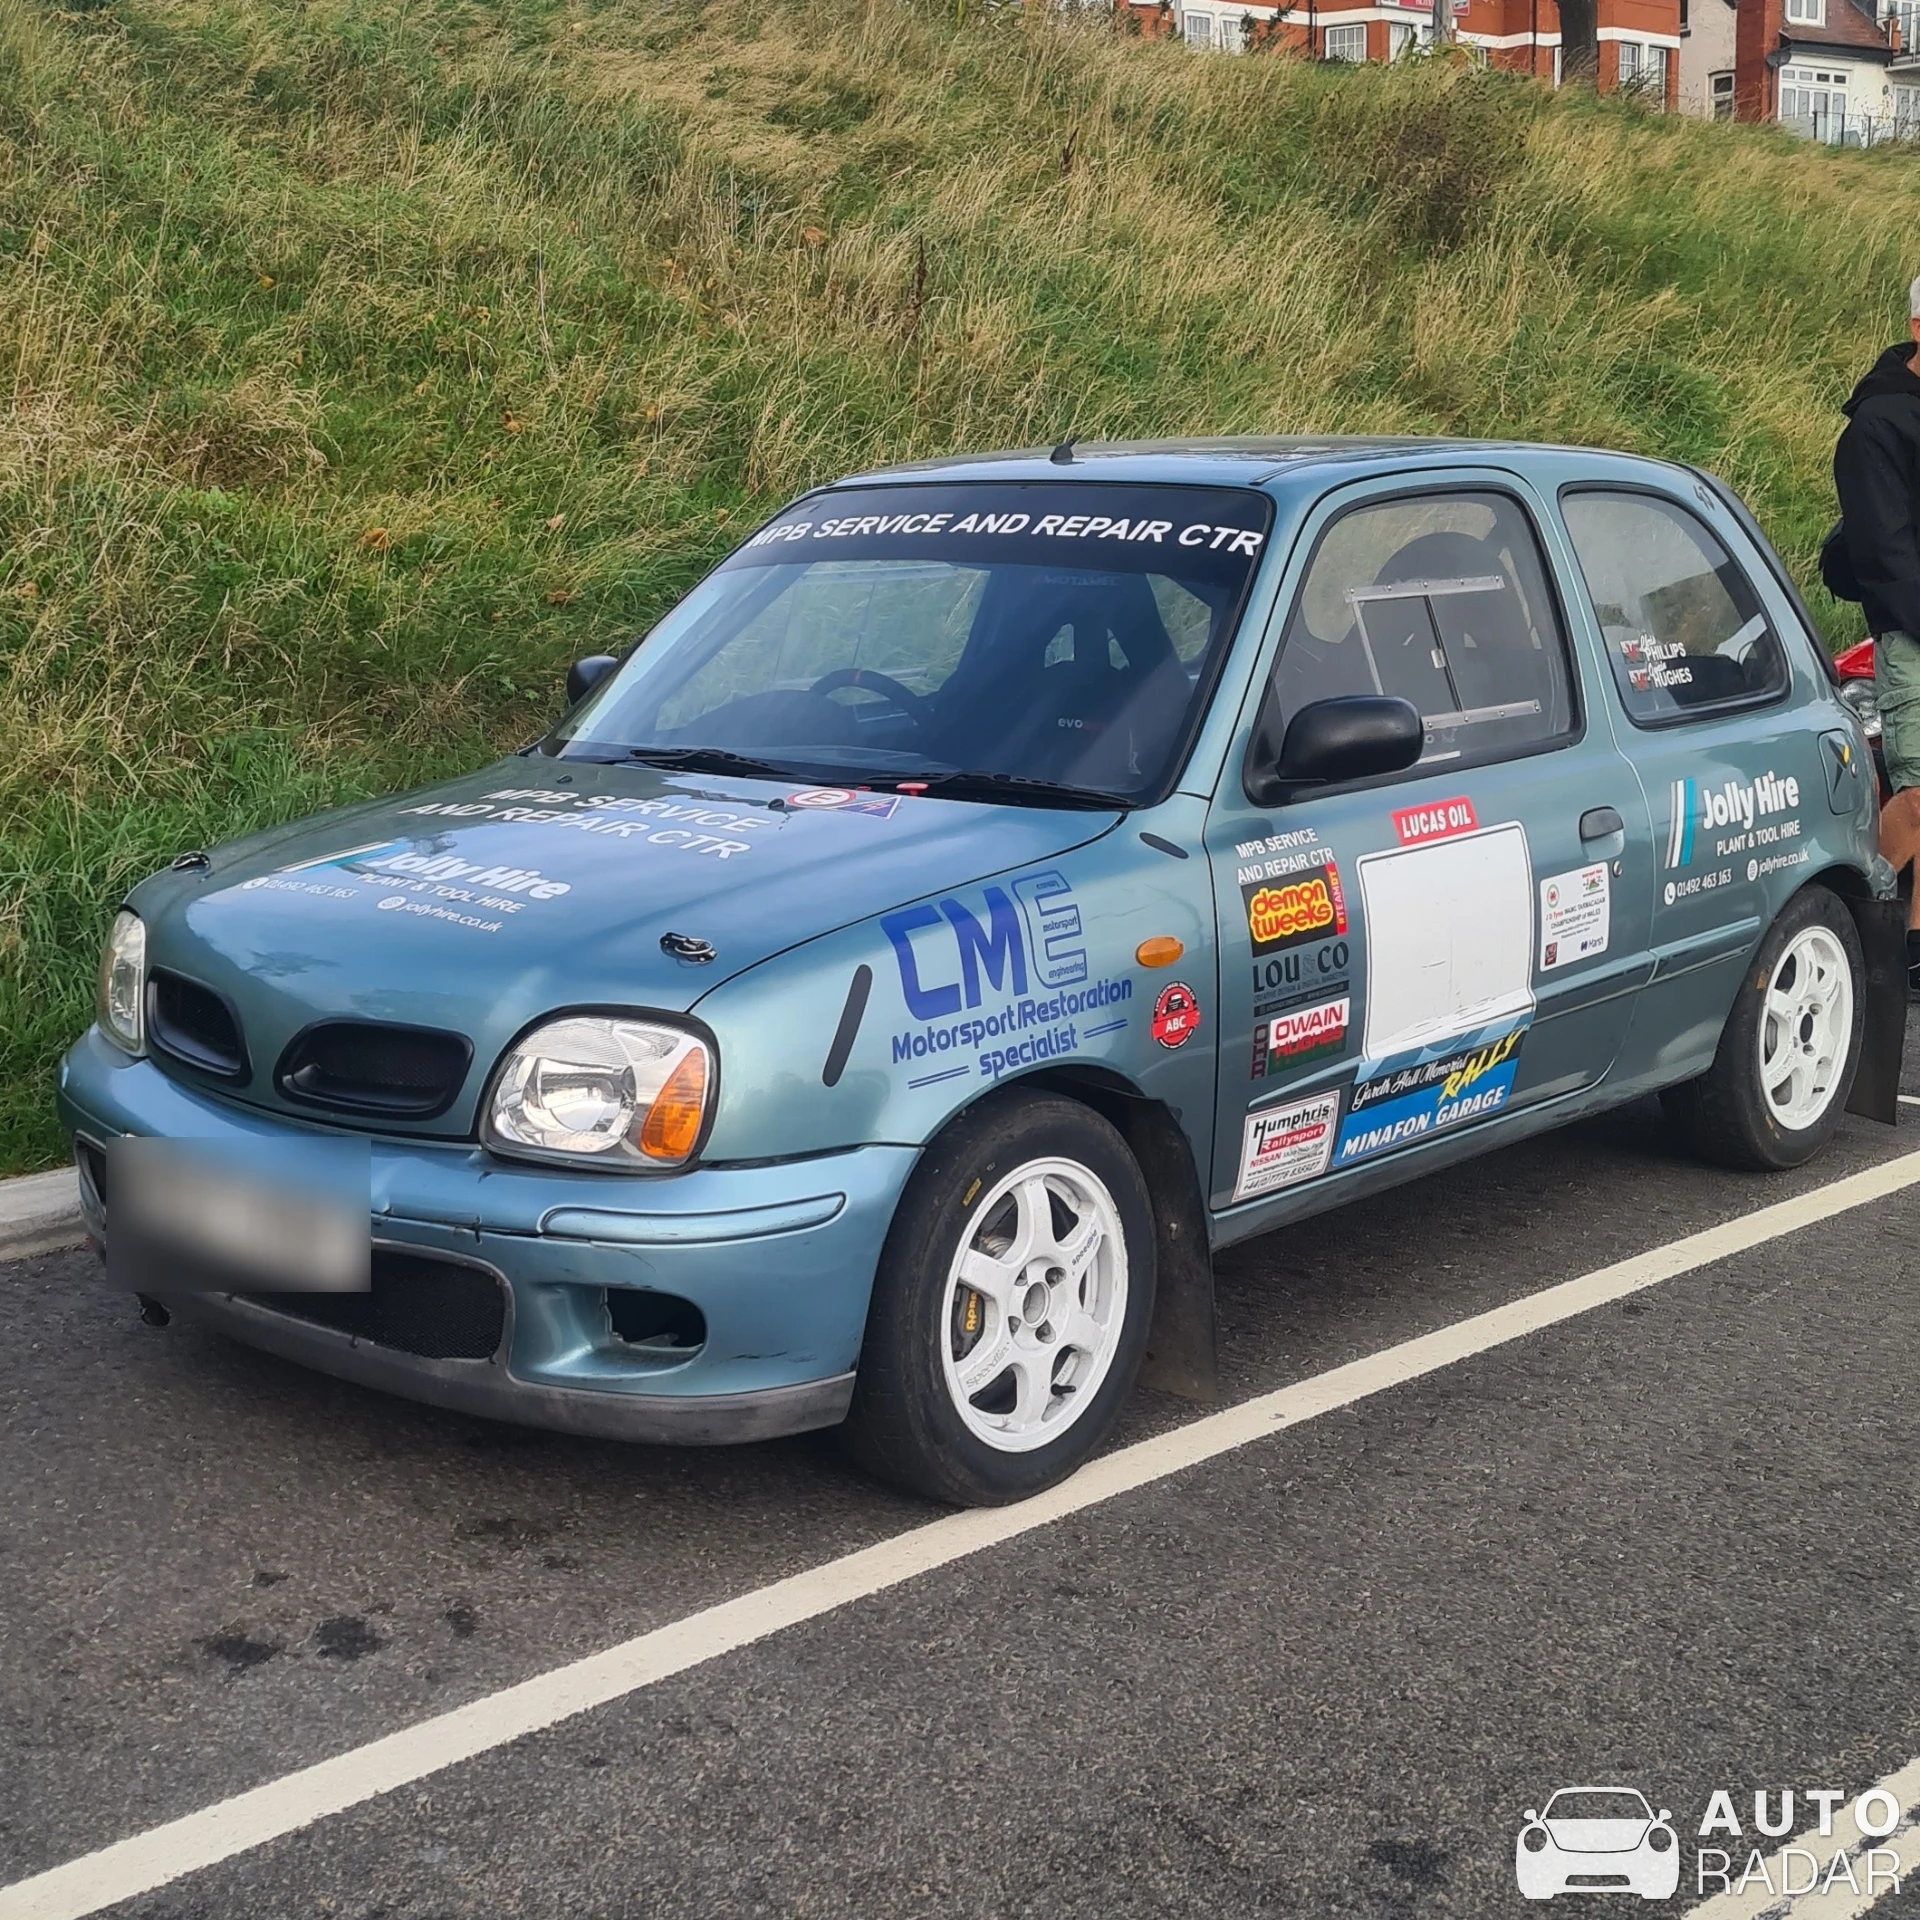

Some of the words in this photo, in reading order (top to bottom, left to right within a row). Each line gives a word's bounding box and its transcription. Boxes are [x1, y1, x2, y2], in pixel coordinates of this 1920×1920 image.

[748, 521, 811, 548] MPB
[813, 513, 954, 538] SERVICE
[949, 513, 1030, 535] AND
[1032, 515, 1173, 543] REPAIR
[1178, 524, 1263, 555] CTR
[1645, 642, 1686, 661] PHILLIPS
[1654, 667, 1692, 688] HUGHES
[479, 789, 579, 804] MPB
[574, 795, 772, 832] SERVICE
[1703, 781, 1754, 830] Jolly
[1754, 770, 1799, 815] Hire
[397, 803, 496, 816] AND
[486, 806, 650, 838] REPAIR
[647, 829, 751, 859] CTR
[1401, 808, 1447, 838] LUCAS
[1448, 803, 1472, 828] OIL
[1716, 833, 1747, 857] PLANT
[1747, 832, 1755, 848] &
[1756, 826, 1780, 846] TOOL
[1780, 819, 1801, 840] HIRE
[1235, 840, 1266, 859] MPB
[1265, 828, 1319, 852] SERVICE
[366, 852, 486, 882] Jolly
[465, 865, 571, 900] Hire
[1237, 864, 1263, 884] AND
[1264, 853, 1309, 878] REPAIR
[1310, 847, 1335, 869] CTR
[1758, 847, 1809, 878] jollyhire.co.uk
[355, 872, 417, 889] PLANT
[410, 882, 429, 892] &
[427, 885, 473, 903] TOOL
[475, 895, 526, 914] HIRE
[1252, 880, 1327, 916] demon
[1677, 877, 1701, 897] 01492
[1701, 872, 1716, 888] 463
[1718, 868, 1732, 885] 163
[397, 900, 503, 933] jollyhire.co.uk
[1251, 903, 1332, 941] tweeks
[1165, 1015, 1186, 1034] ABC
[1275, 1004, 1343, 1041] OWAIN
[979, 1024, 1078, 1080] specialist
[1437, 1024, 1529, 1106] RALLY
[1352, 1076, 1391, 1111] Gareth
[1391, 1069, 1420, 1094] Hall
[1419, 1052, 1470, 1084] Memorial
[1253, 1104, 1330, 1156] Humphris
[1261, 1125, 1324, 1151] Rallysport
[1341, 1111, 1431, 1158] MINAFON
[1436, 1085, 1506, 1126] GARAGE
[1250, 1151, 1281, 1169] NISSAN
